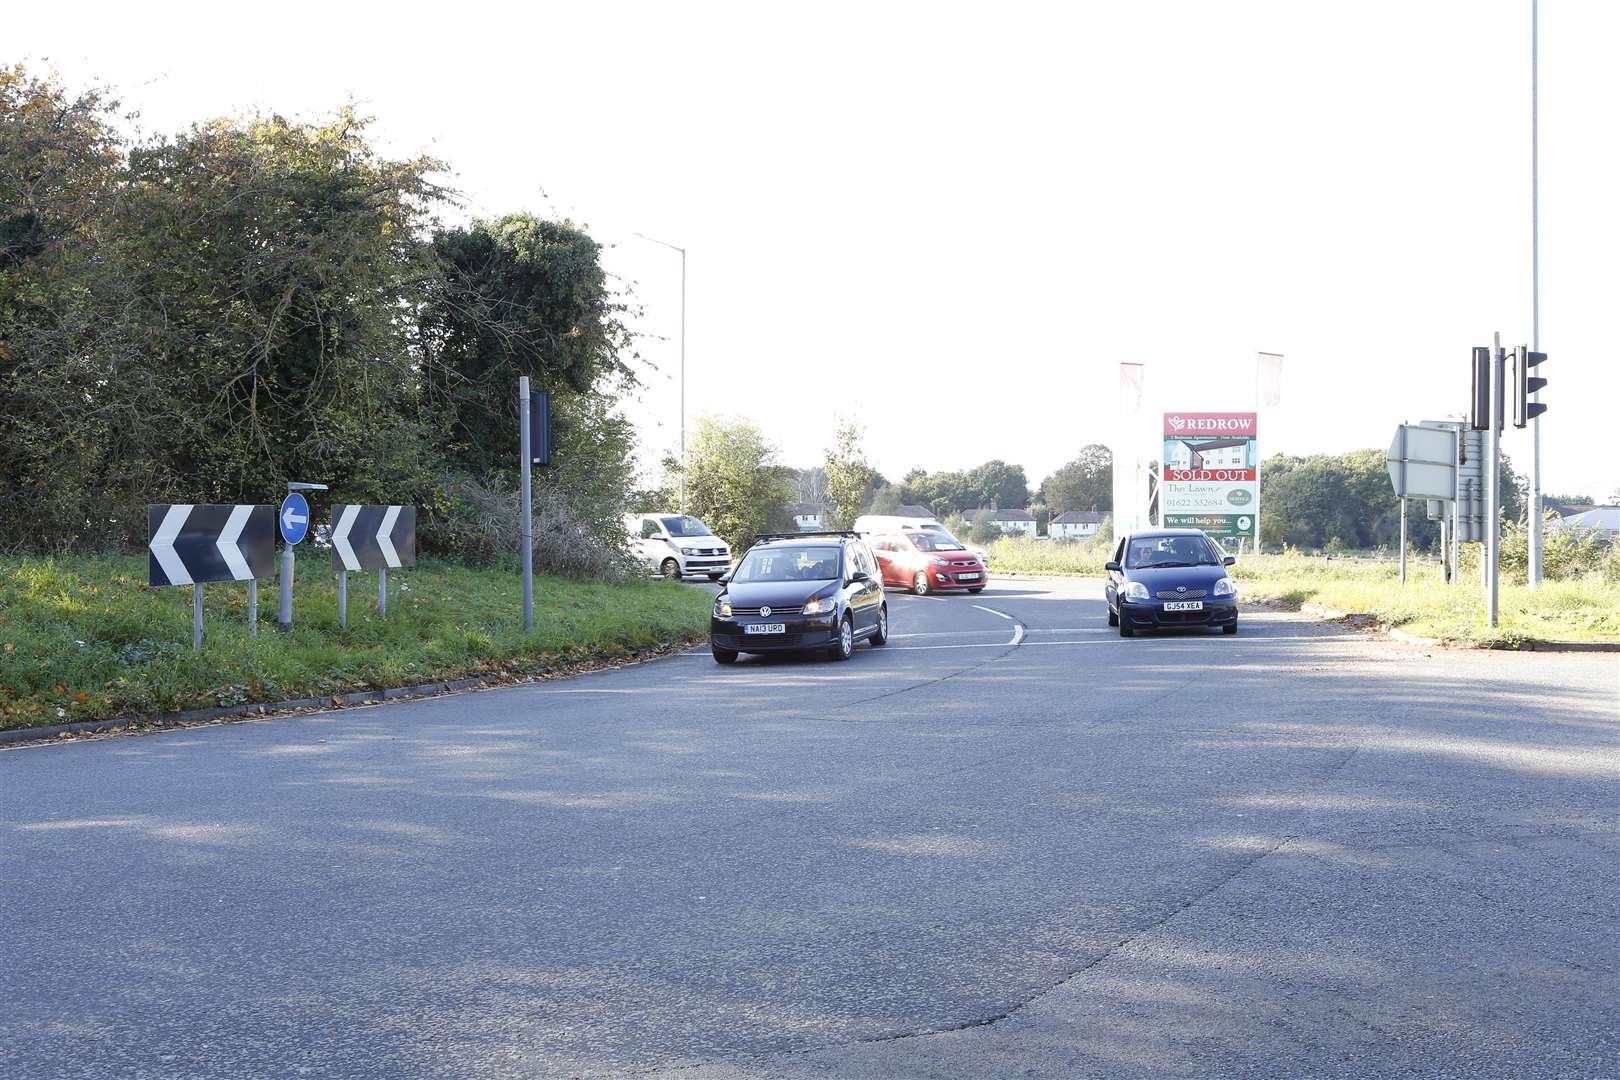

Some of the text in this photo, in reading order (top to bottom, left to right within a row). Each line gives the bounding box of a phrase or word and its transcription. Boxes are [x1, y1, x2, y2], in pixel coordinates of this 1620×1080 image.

[1187, 418, 1251, 430] REDROW
[1173, 470, 1247, 481] SOLD OUT
[1168, 484, 1185, 493] The
[1166, 516, 1179, 524] We
[1180, 516, 1195, 524] will
[1195, 516, 1211, 526] help
[750, 624, 783, 632] NA13 URD
